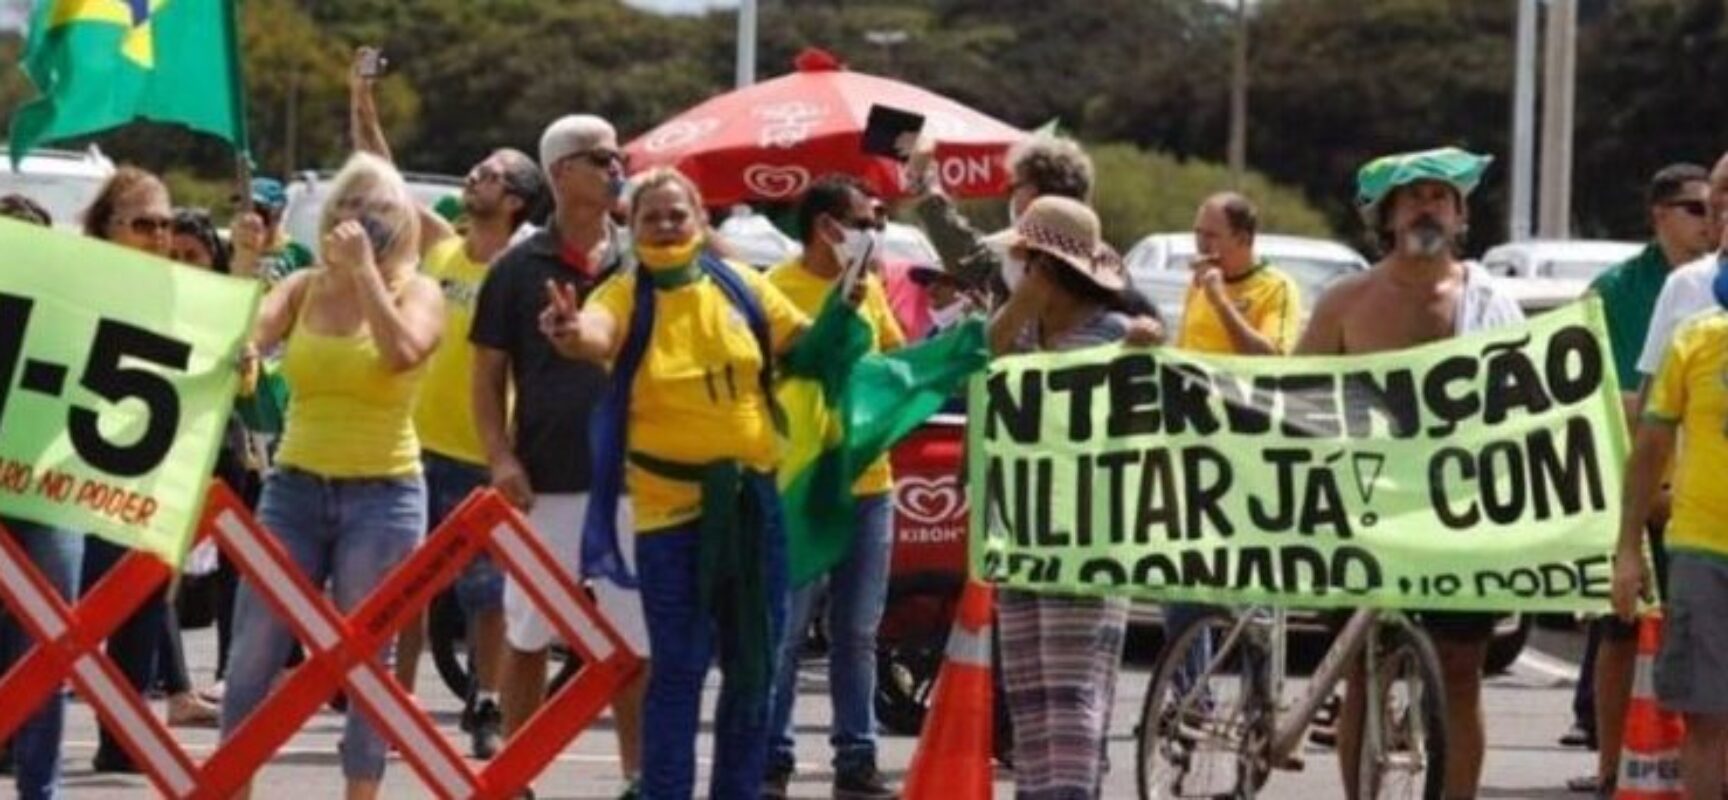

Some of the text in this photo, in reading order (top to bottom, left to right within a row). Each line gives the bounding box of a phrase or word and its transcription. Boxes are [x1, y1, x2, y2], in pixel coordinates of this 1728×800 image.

[984, 325, 1603, 442] NTERVENÇÃO
[0, 458, 158, 527] RO NO PODER
[1428, 415, 1606, 530] COM
[1473, 555, 1618, 598] PODE
